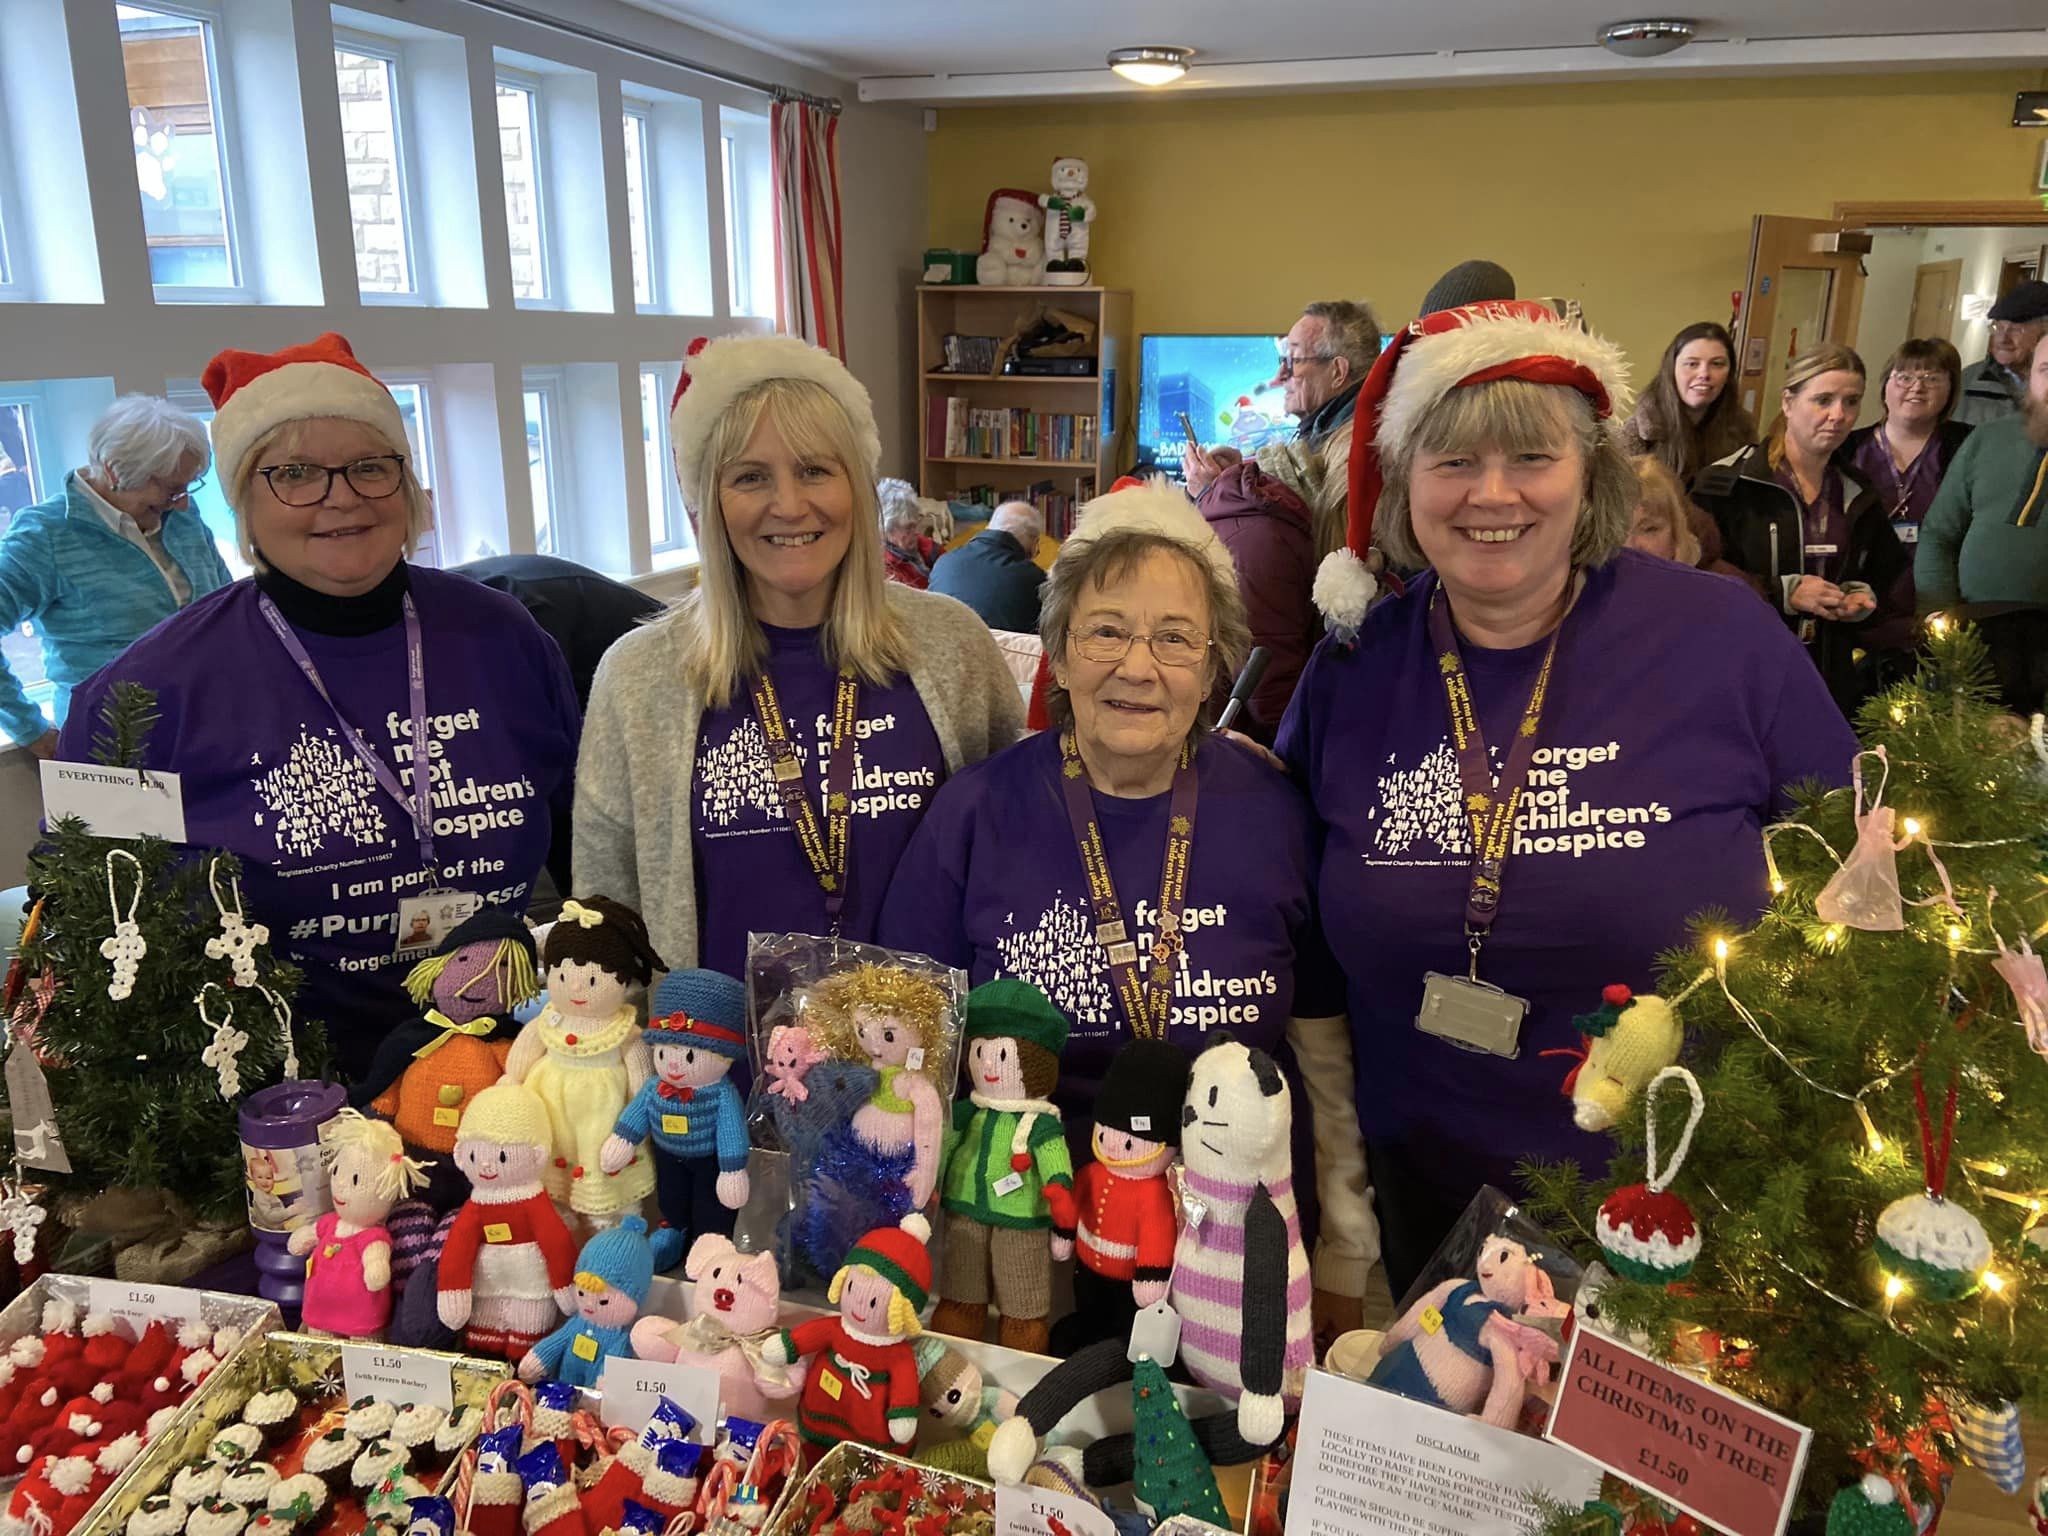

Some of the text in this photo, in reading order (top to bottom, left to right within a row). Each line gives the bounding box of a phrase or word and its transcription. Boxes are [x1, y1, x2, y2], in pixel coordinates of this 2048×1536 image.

[763, 720, 775, 744] orget
[815, 714, 895, 739] fget
[1454, 716, 1467, 750] hospice
[818, 741, 859, 756] m
[1531, 741, 1620, 770] orget
[59, 770, 134, 786] EVERYTHING
[819, 753, 863, 774] nt
[820, 765, 935, 793] cildren's
[1519, 786, 1570, 808] not
[413, 804, 524, 839] ospice
[1493, 786, 1520, 859] ildren's hospice
[1514, 802, 1672, 831] children's
[1080, 840, 1090, 856] not
[1177, 839, 1190, 868] forget
[1512, 825, 1646, 858] hospice
[278, 867, 313, 878] Registered
[314, 863, 338, 871] Charity
[368, 853, 392, 862] 1110457
[1088, 822, 1112, 898] children's hospice
[1166, 838, 1179, 879] children's
[332, 856, 505, 900] I am par of the
[1089, 871, 1102, 900] forget
[1174, 884, 1182, 900] not
[1135, 900, 1227, 932] foget
[1139, 950, 1189, 972] nt
[1120, 985, 1131, 1002] not
[1142, 969, 1277, 997] ildren's
[1126, 967, 1152, 1037] hildren's hospice
[1158, 989, 1171, 1019] forget
[1170, 997, 1260, 1031] ospice
[129, 1292, 155, 1304] £1.50
[355, 1372, 373, 1380] (with
[373, 1357, 402, 1369] £1.50
[636, 1380, 666, 1393] £1.50
[1577, 1348, 1790, 1462] ALL ITEMS ON THE
[1577, 1375, 1776, 1487] CHRISTMAS TREE
[1323, 1428, 1354, 1443] THESE
[1356, 1439, 1387, 1455] ITEMS
[1389, 1448, 1416, 1465] HAVE
[1419, 1458, 1446, 1474] BEEN
[1448, 1468, 1501, 1493] LOVINGLY
[1416, 1434, 1480, 1462] DISCLAIMER
[1319, 1462, 1334, 1474] DO
[1335, 1467, 1356, 1480] NOT
[1358, 1475, 1386, 1490] HAVE
[1386, 1485, 1402, 1496] AN
[1320, 1450, 1378, 1476] THEREFORE
[1381, 1470, 1407, 1485] THEY
[1409, 1478, 1438, 1496] HAVE
[1440, 1489, 1461, 1503] NOT
[1463, 1497, 1491, 1513] BEEN
[1321, 1439, 1367, 1461] LOCALLY
[1369, 1454, 1383, 1466] TO
[1385, 1459, 1415, 1477] RAISE
[1416, 1470, 1450, 1488] FUNDS
[1453, 1482, 1474, 1496] FOR
[1476, 1487, 1499, 1503] OUR
[1637, 1448, 1689, 1486] £1.50
[1031, 1503, 1064, 1520] £1.50
[1314, 1496, 1357, 1517] PLAYING
[1360, 1511, 1386, 1526] WITH
[1316, 1485, 1425, 1528] CHILDREN SHOULD BE
[1009, 1521, 1030, 1533] (with
[1311, 1519, 1320, 1528] IF
[1323, 1521, 1344, 1535] YOU
